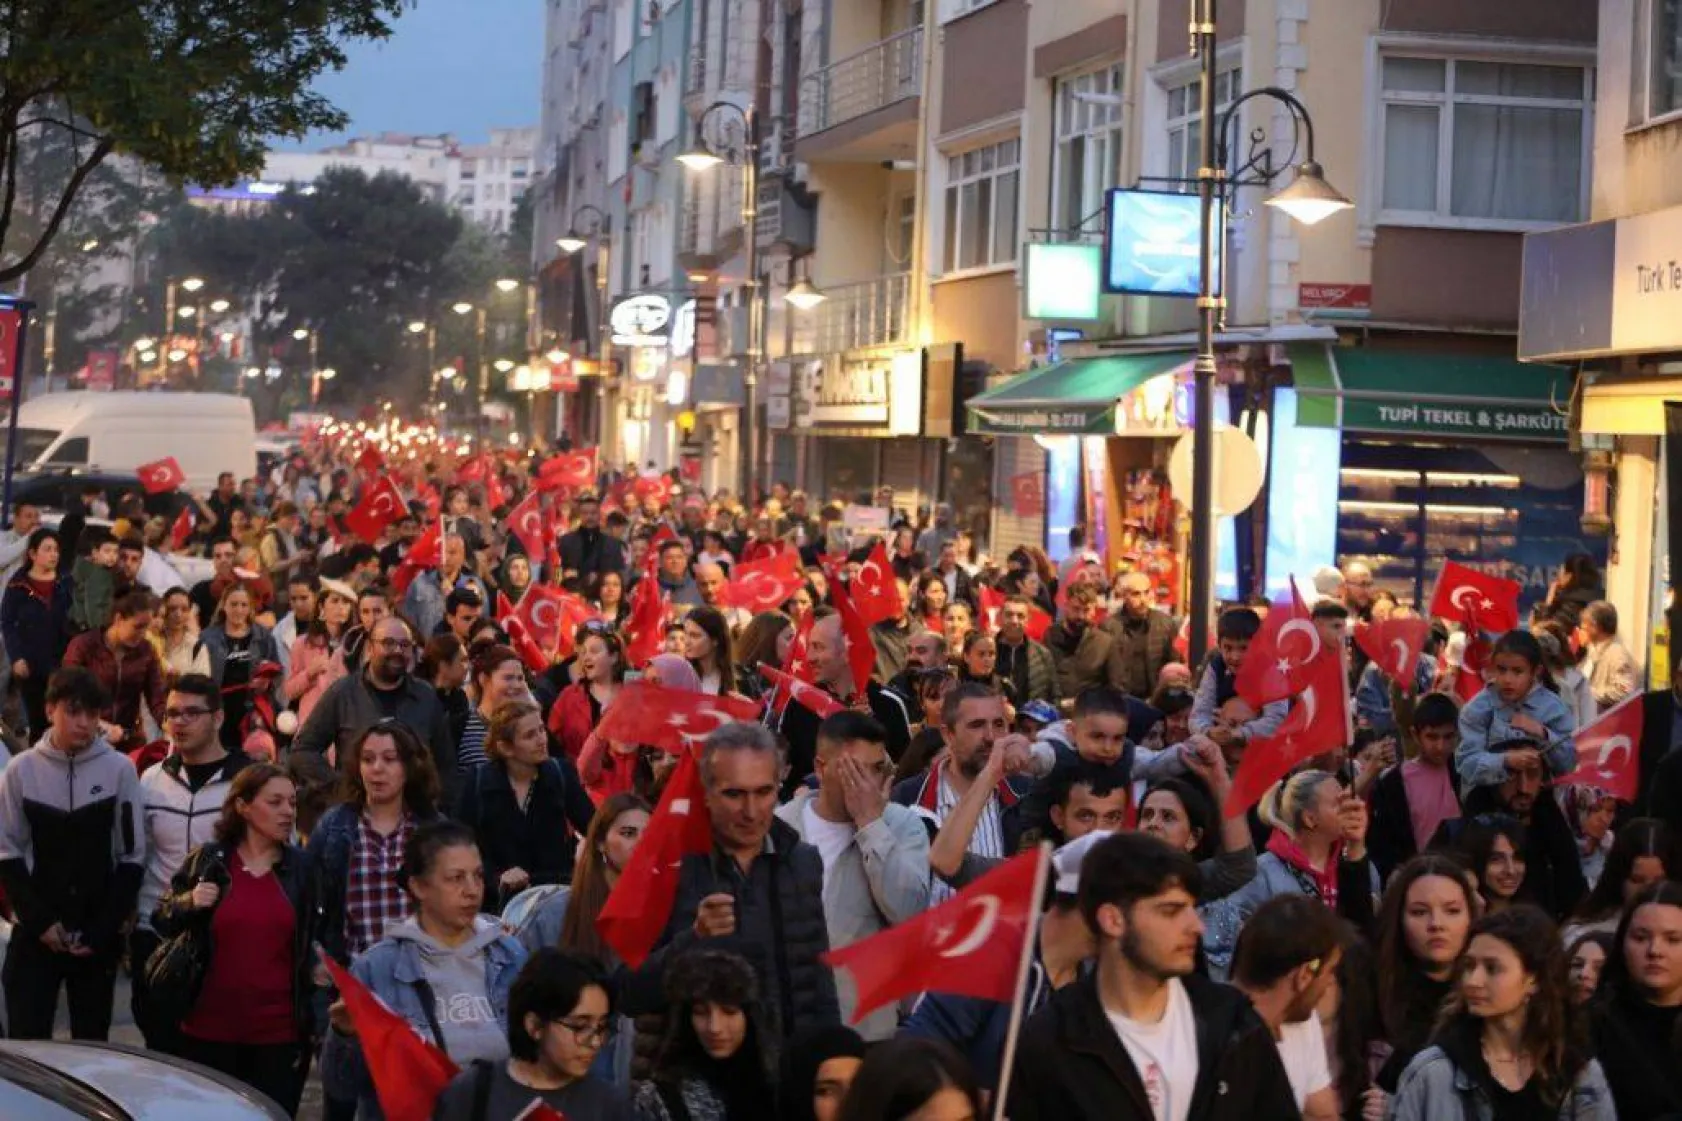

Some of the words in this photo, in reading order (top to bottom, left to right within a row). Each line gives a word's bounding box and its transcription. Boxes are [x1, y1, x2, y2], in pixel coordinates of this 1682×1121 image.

[1637, 264, 1665, 294] Türk
[1378, 404, 1418, 423] TUPİ
[1423, 408, 1473, 427] TEKEL
[1476, 410, 1491, 427] &
